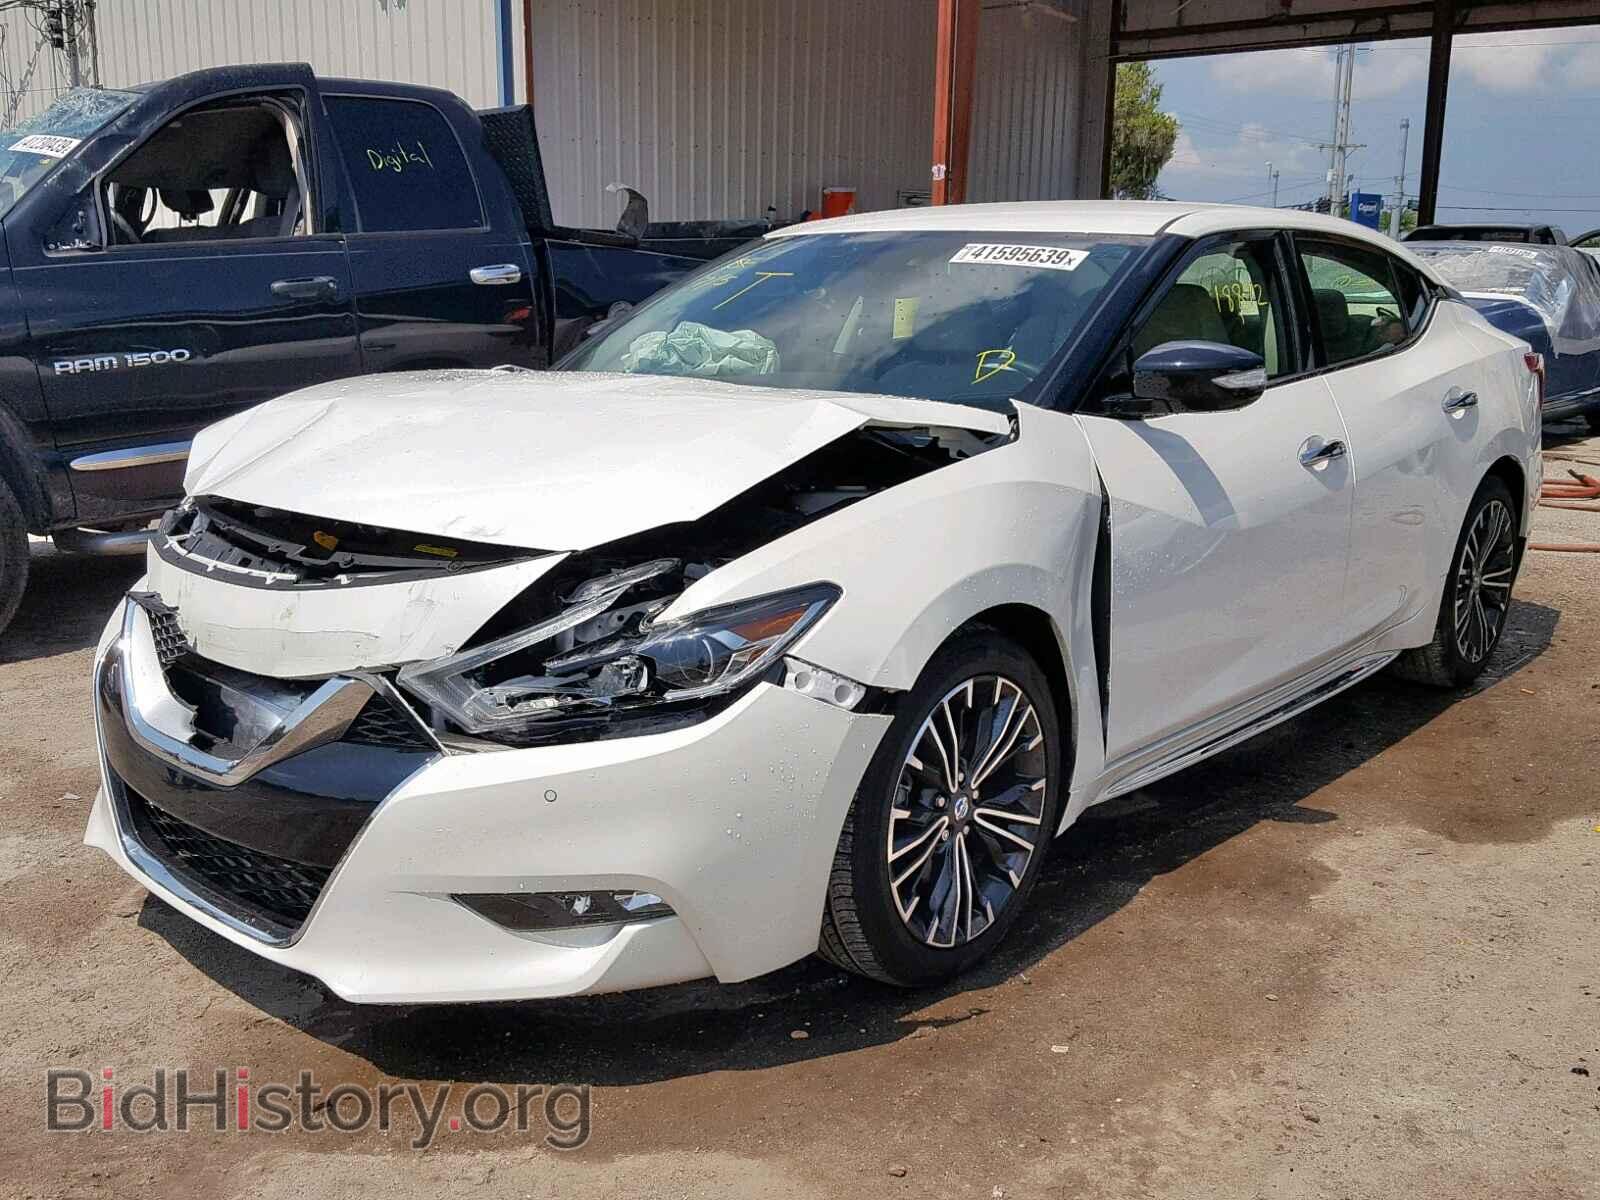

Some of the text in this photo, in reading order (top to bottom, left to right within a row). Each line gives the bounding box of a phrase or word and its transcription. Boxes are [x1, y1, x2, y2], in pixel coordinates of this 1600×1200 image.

[366, 138, 434, 173] Digital
[54, 349, 190, 375] RAM 1500
